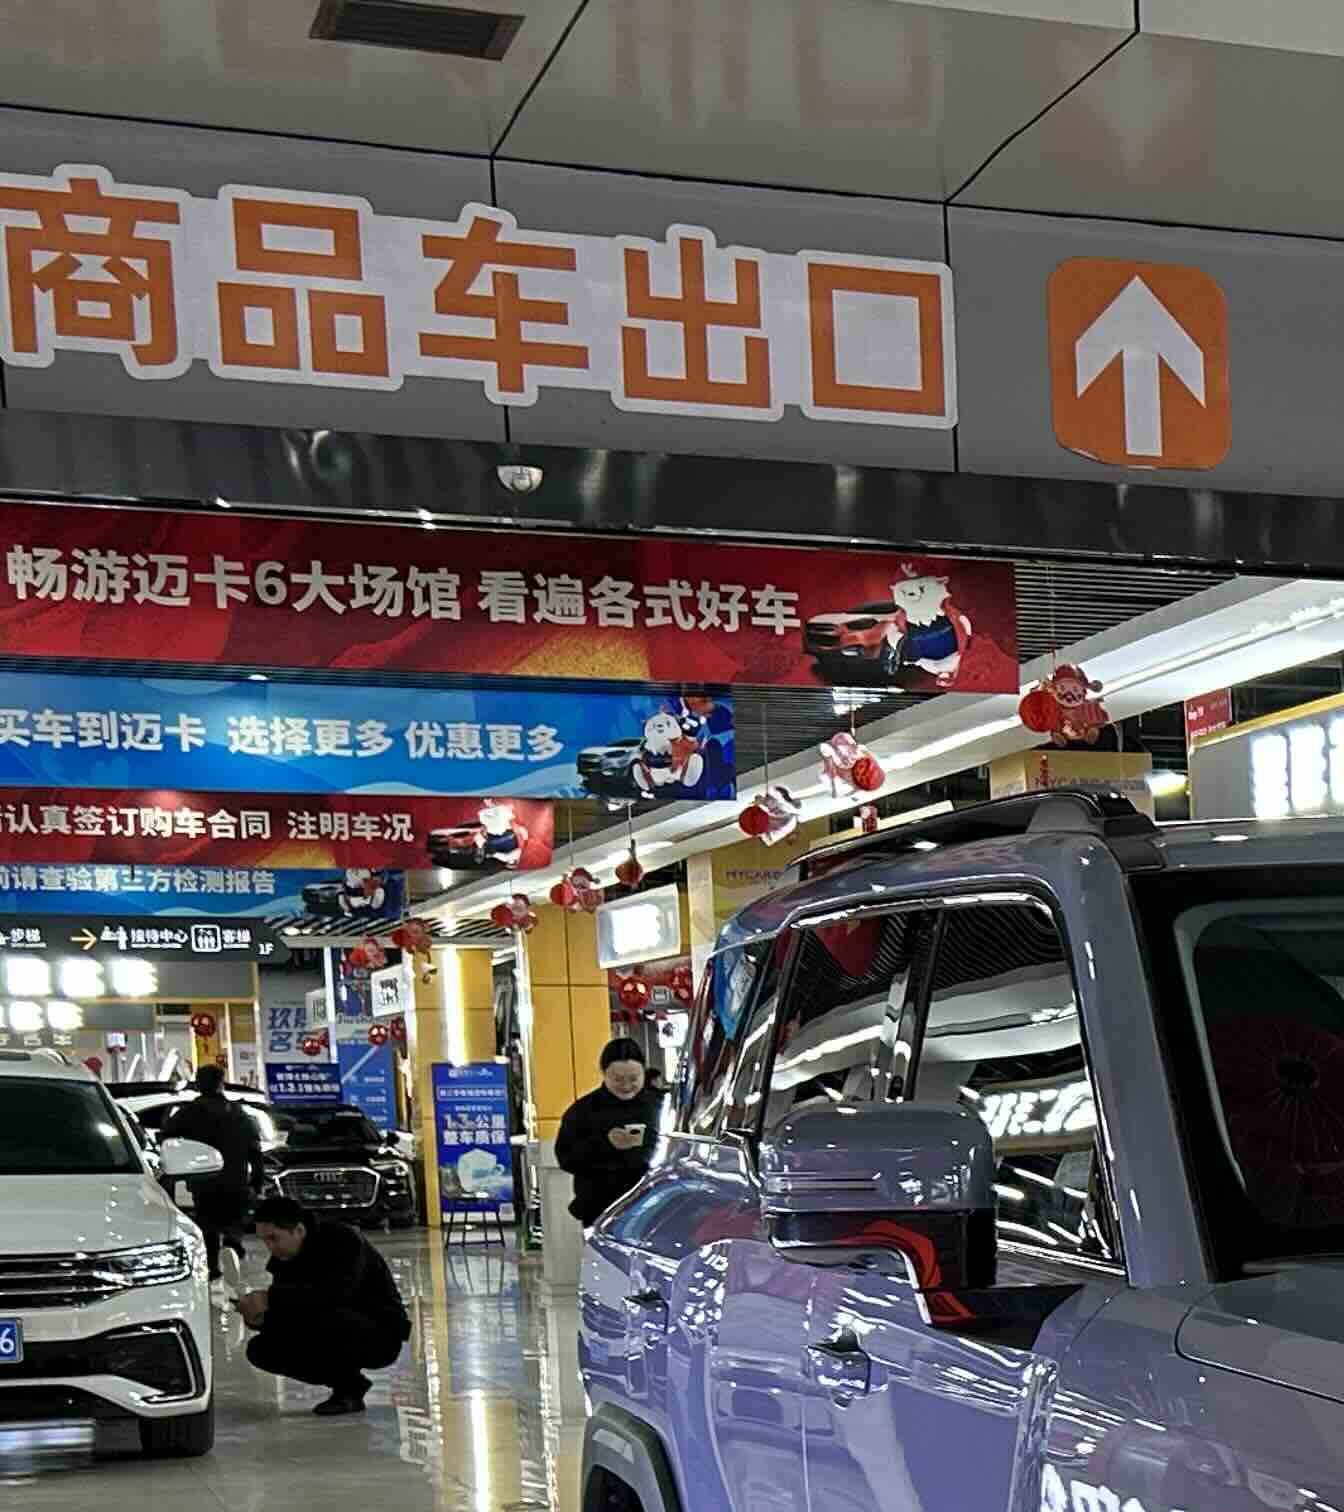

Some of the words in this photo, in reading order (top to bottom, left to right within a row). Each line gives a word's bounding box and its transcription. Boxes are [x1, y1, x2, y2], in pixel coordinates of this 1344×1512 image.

[0, 172, 950, 422] 商品车出口
[6, 544, 461, 622] 畅游迈卡6大场馆
[478, 569, 802, 637] 看遍各式好车
[0, 708, 207, 752] 买车到迈卡
[227, 714, 395, 759] 选择更多
[404, 722, 567, 763] 优惠更多
[0, 804, 272, 840] 认真签订购车合同
[287, 809, 415, 843] 注明车况
